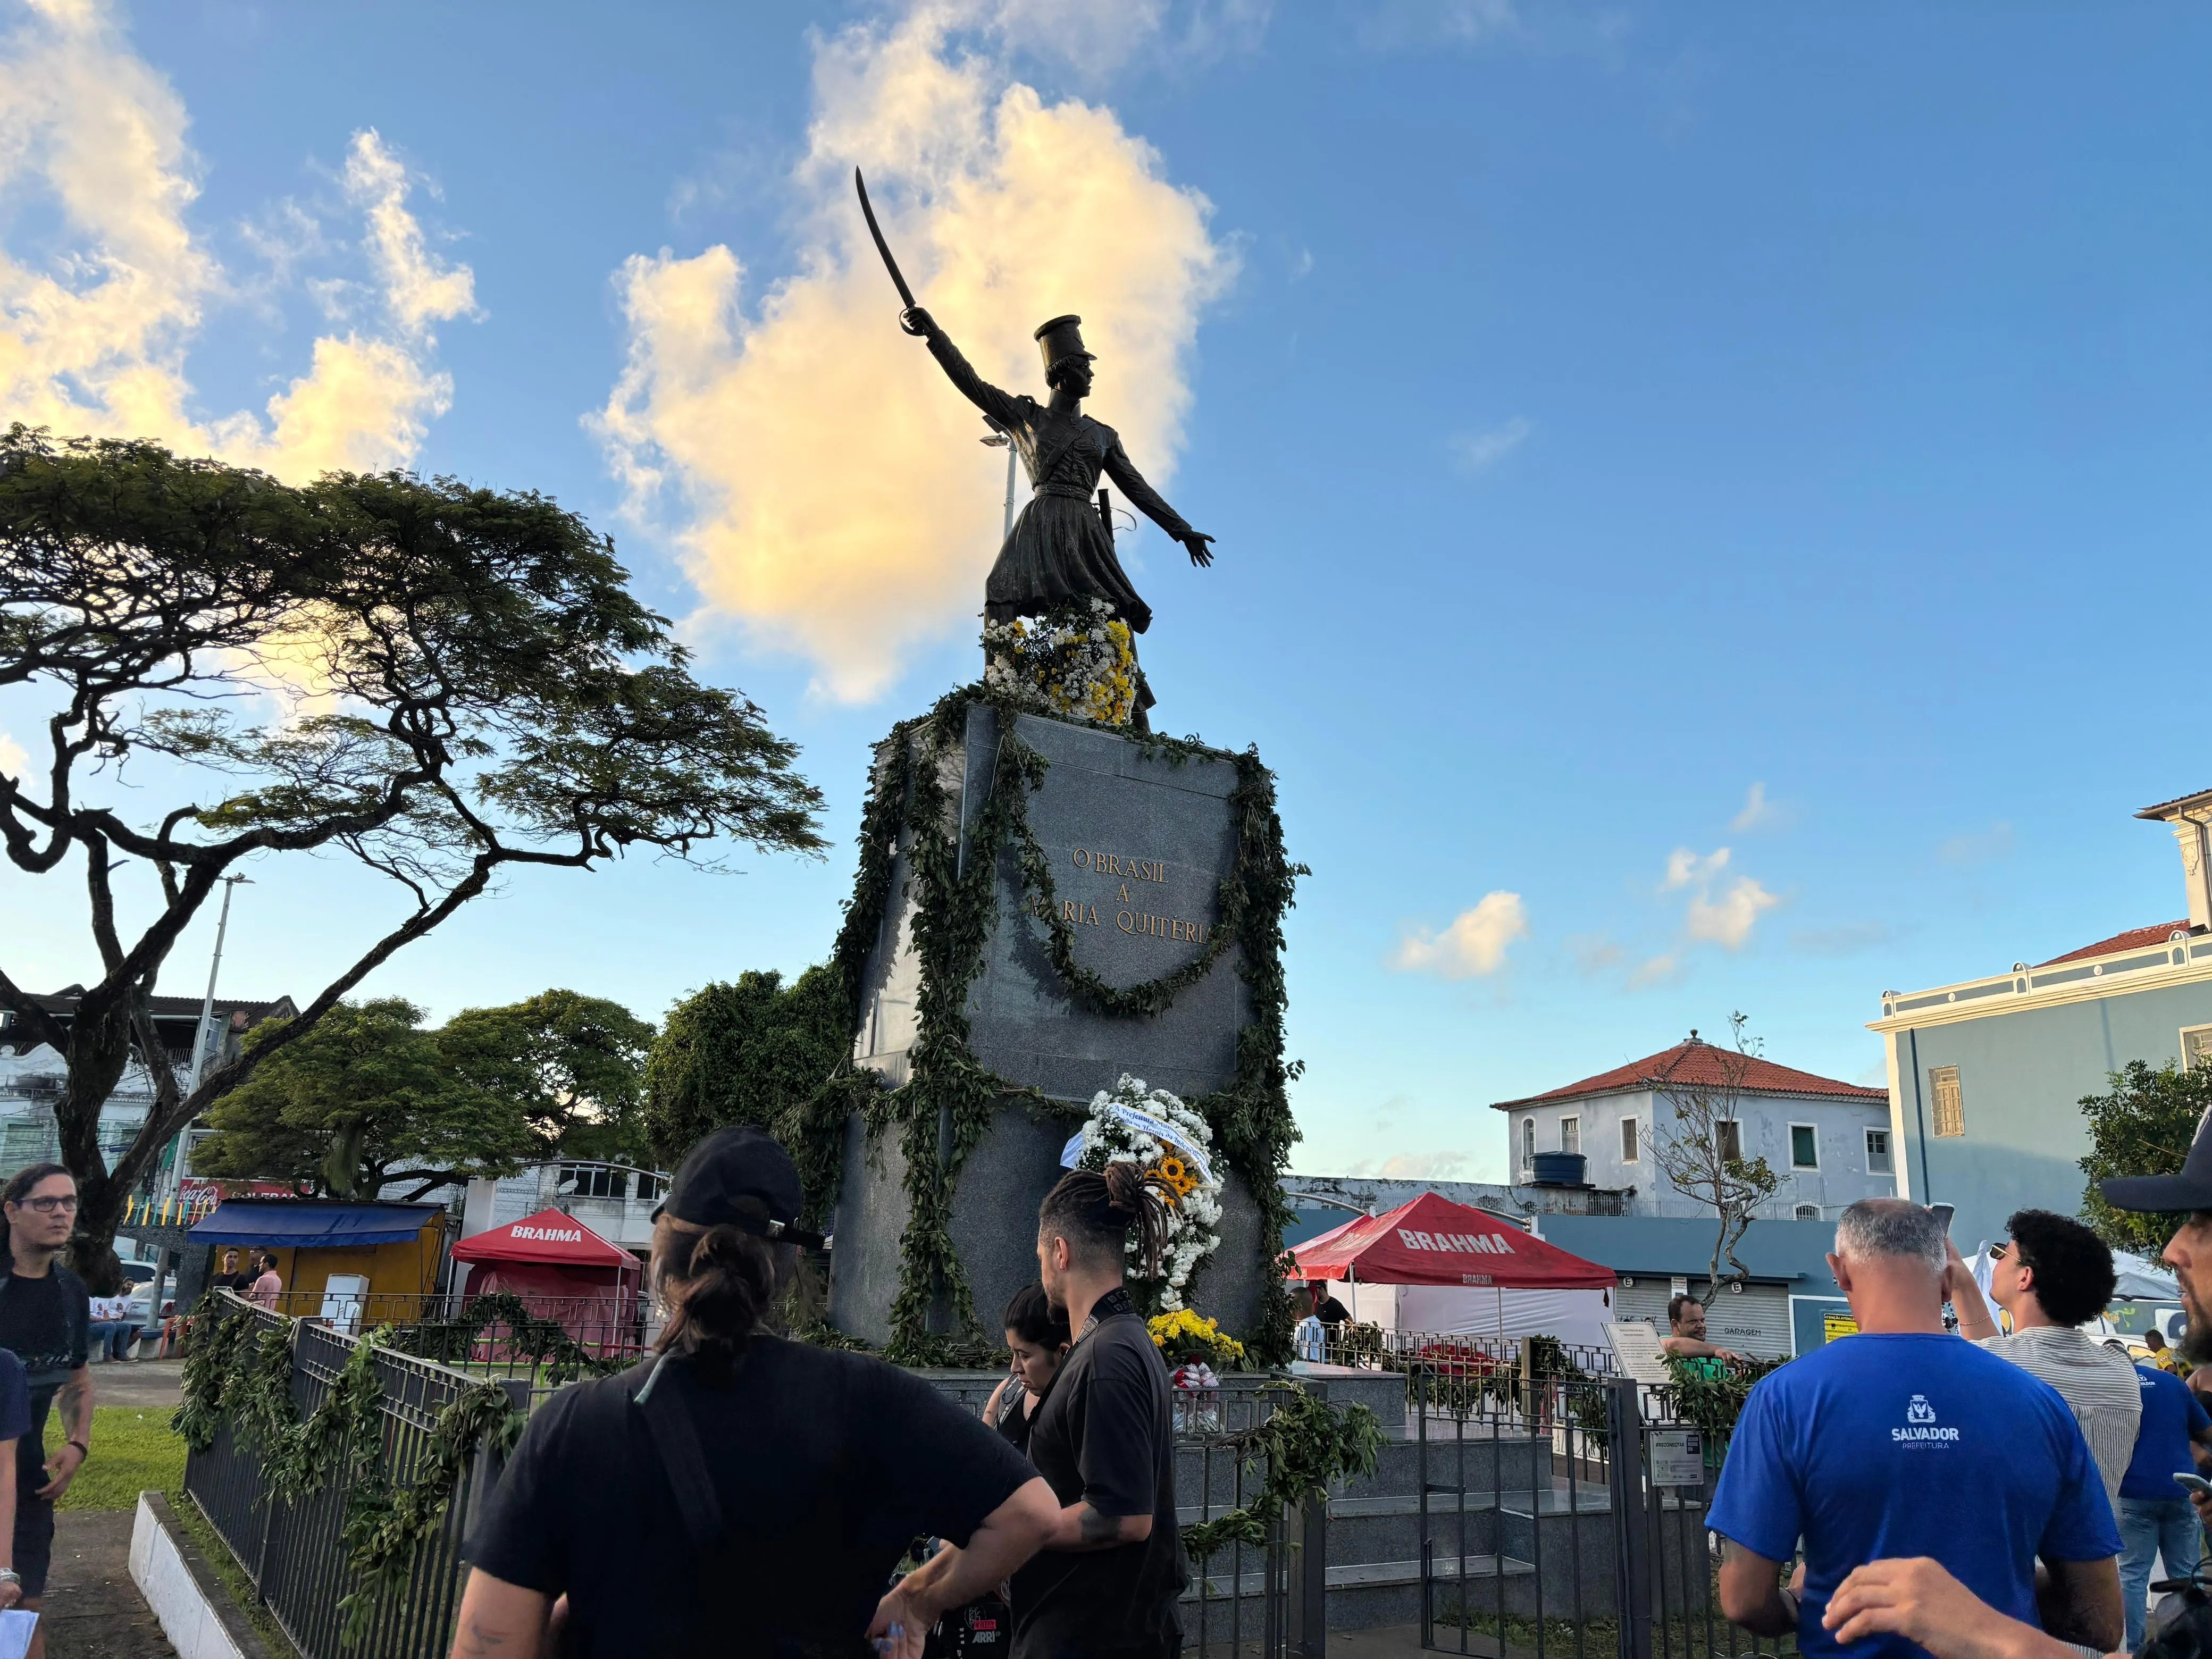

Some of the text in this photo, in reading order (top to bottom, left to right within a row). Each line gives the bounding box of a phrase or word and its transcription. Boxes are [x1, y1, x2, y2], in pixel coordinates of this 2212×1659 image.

[1073, 848, 1169, 883] O BRASIL
[1116, 882, 1129, 902] A
[1030, 895, 1099, 926] MRIA
[1121, 1108, 1154, 1124] Prefeitura
[510, 1225, 581, 1242] BRAHMA
[1396, 1228, 1516, 1254] BRAHMA
[1462, 1273, 1493, 1285] BRAHMA
[1724, 1327, 1761, 1336] GARAGEM
[1891, 1427, 1959, 1441] SALVADOR
[972, 1630, 995, 1644] ARRI
